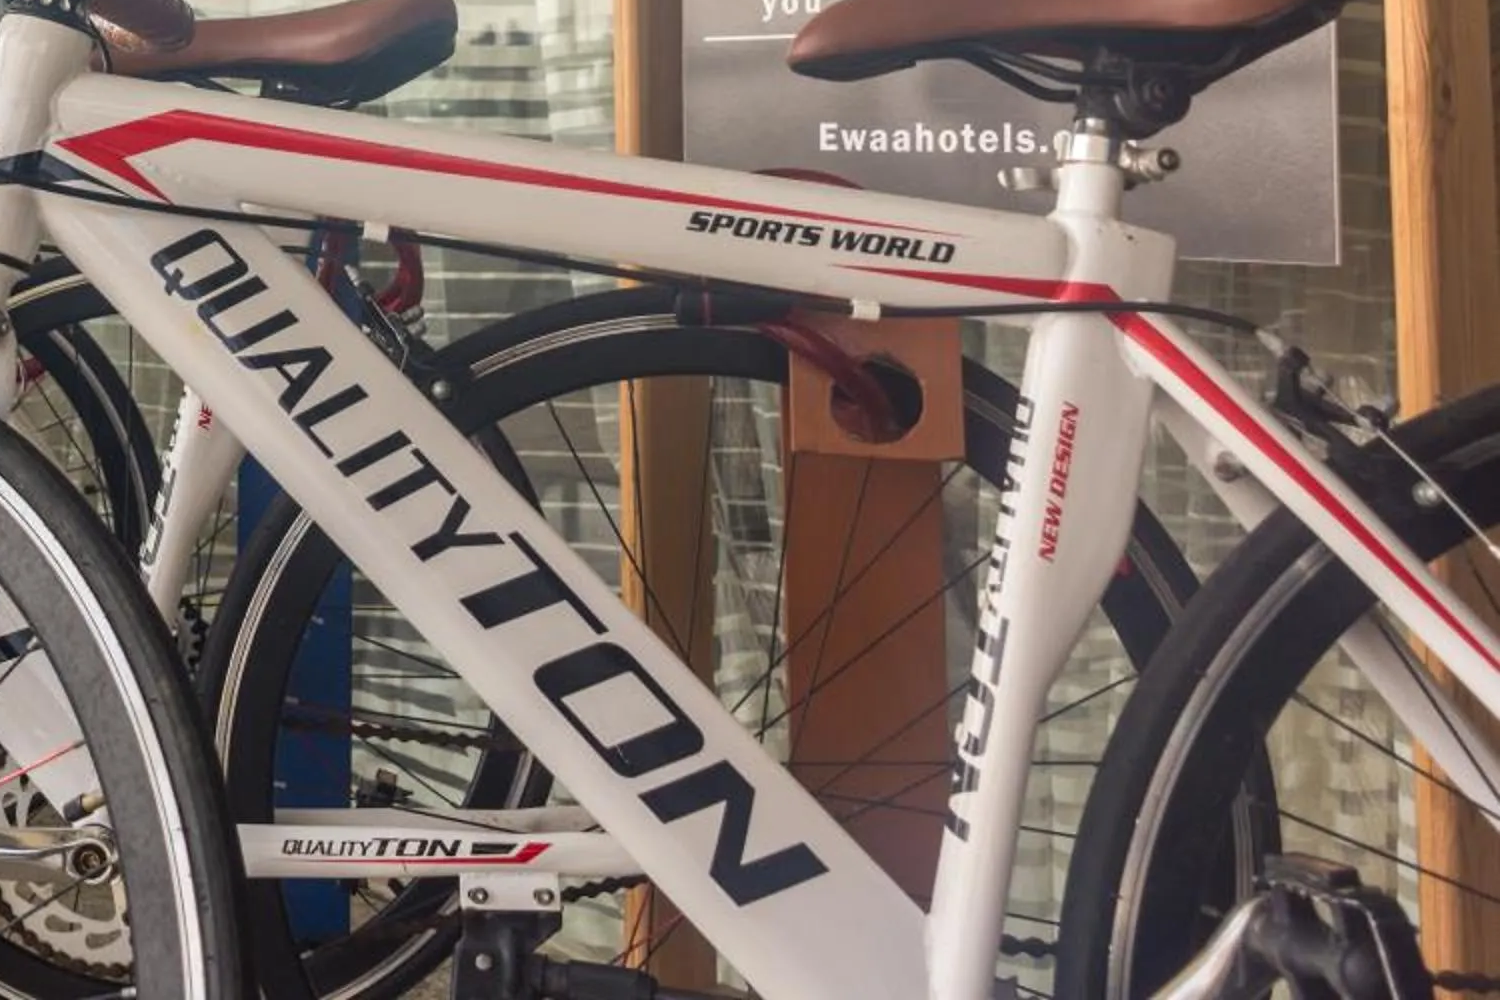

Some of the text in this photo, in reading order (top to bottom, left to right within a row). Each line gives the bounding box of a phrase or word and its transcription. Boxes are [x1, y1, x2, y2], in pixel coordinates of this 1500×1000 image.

[686, 210, 956, 264] SPORTS WORLD
[1038, 400, 1081, 564] NEW DESIGN
